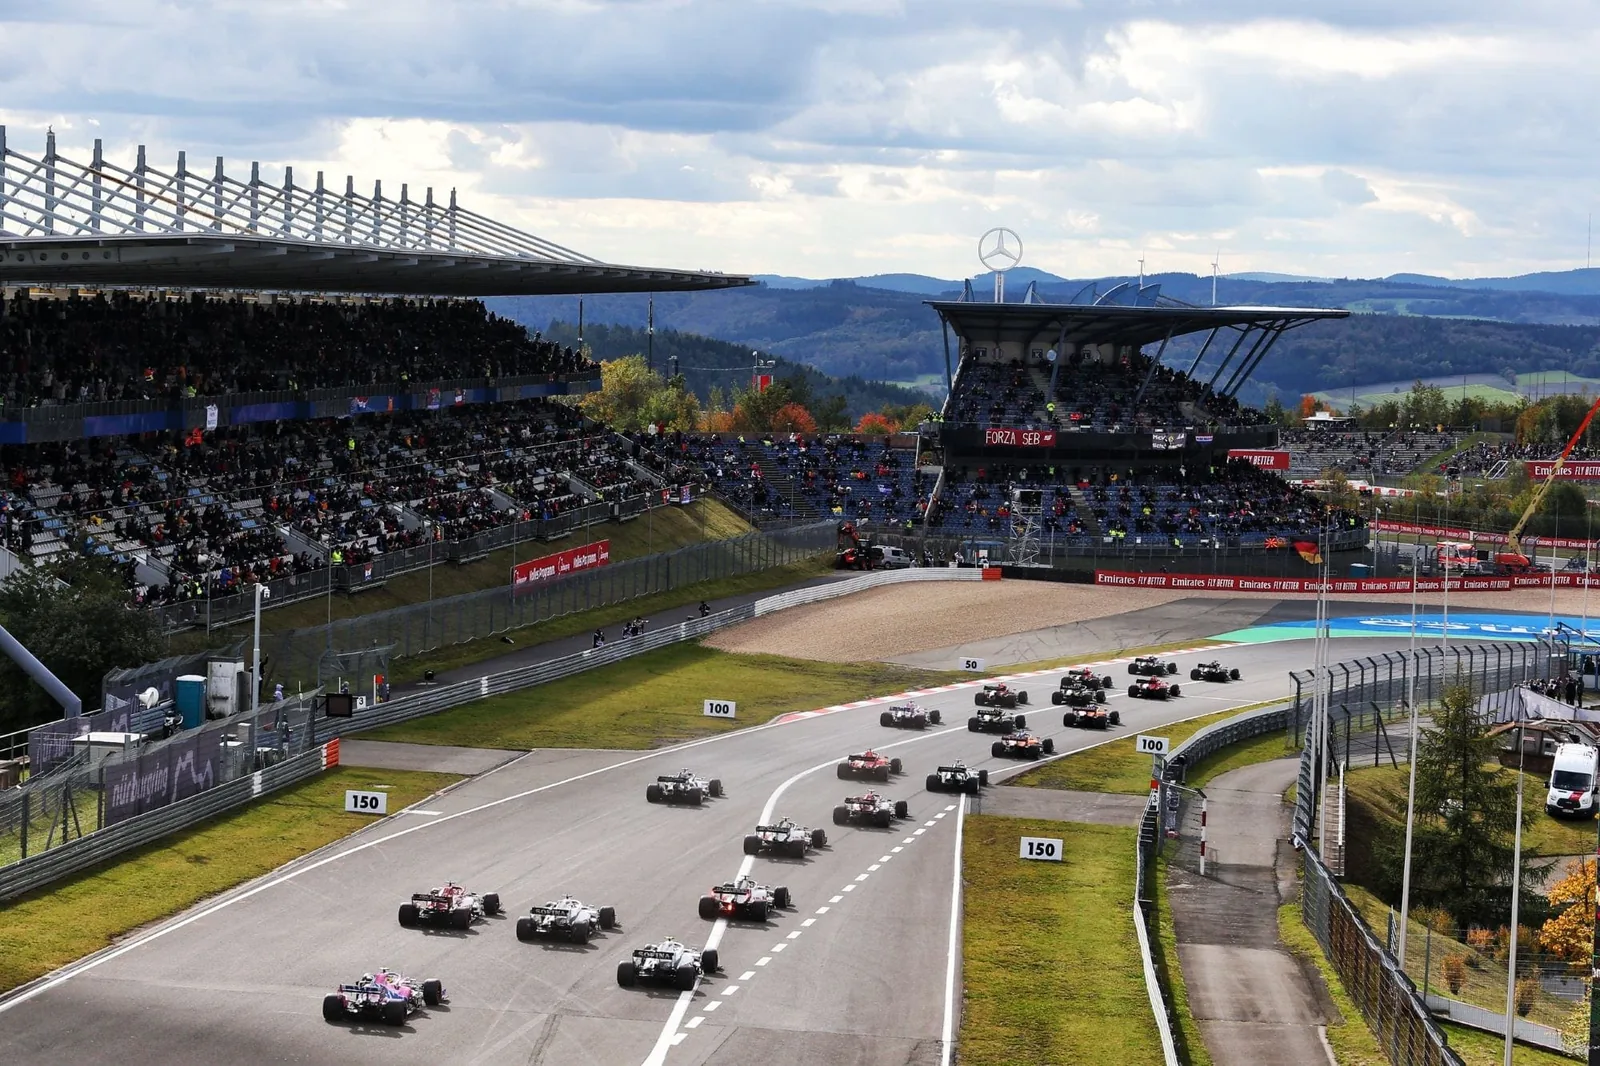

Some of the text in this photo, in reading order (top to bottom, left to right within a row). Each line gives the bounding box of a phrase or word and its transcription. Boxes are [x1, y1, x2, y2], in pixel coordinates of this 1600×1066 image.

[985, 431, 1041, 445] FORZA SEB
[1252, 455, 1275, 466] BETTER
[1575, 466, 1585, 476] FLY
[1098, 573, 1136, 585] Emirates
[1138, 576, 1147, 585] FLY
[1147, 576, 1166, 586] BETTER
[1172, 577, 1205, 587] Emirates
[1207, 578, 1217, 587] FLY
[1217, 579, 1235, 588] BETTER
[1239, 580, 1271, 589] Emirates
[1273, 581, 1282, 589] FLY
[1282, 581, 1299, 590] BETTER
[1362, 582, 1388, 590] Emirates
[1464, 580, 1489, 588] Emirates
[1514, 577, 1541, 585] Emirates
[1542, 576, 1552, 585] FLY
[965, 660, 977, 669] 50
[358, 696, 364, 705] 3
[709, 703, 729, 714] 100
[1142, 739, 1163, 751] 100
[112, 762, 169, 807] nürburgring
[352, 795, 379, 809] 150
[1152, 795, 1157, 803] 3
[1028, 842, 1055, 857] 150
[638, 951, 670, 959] SOFINA
